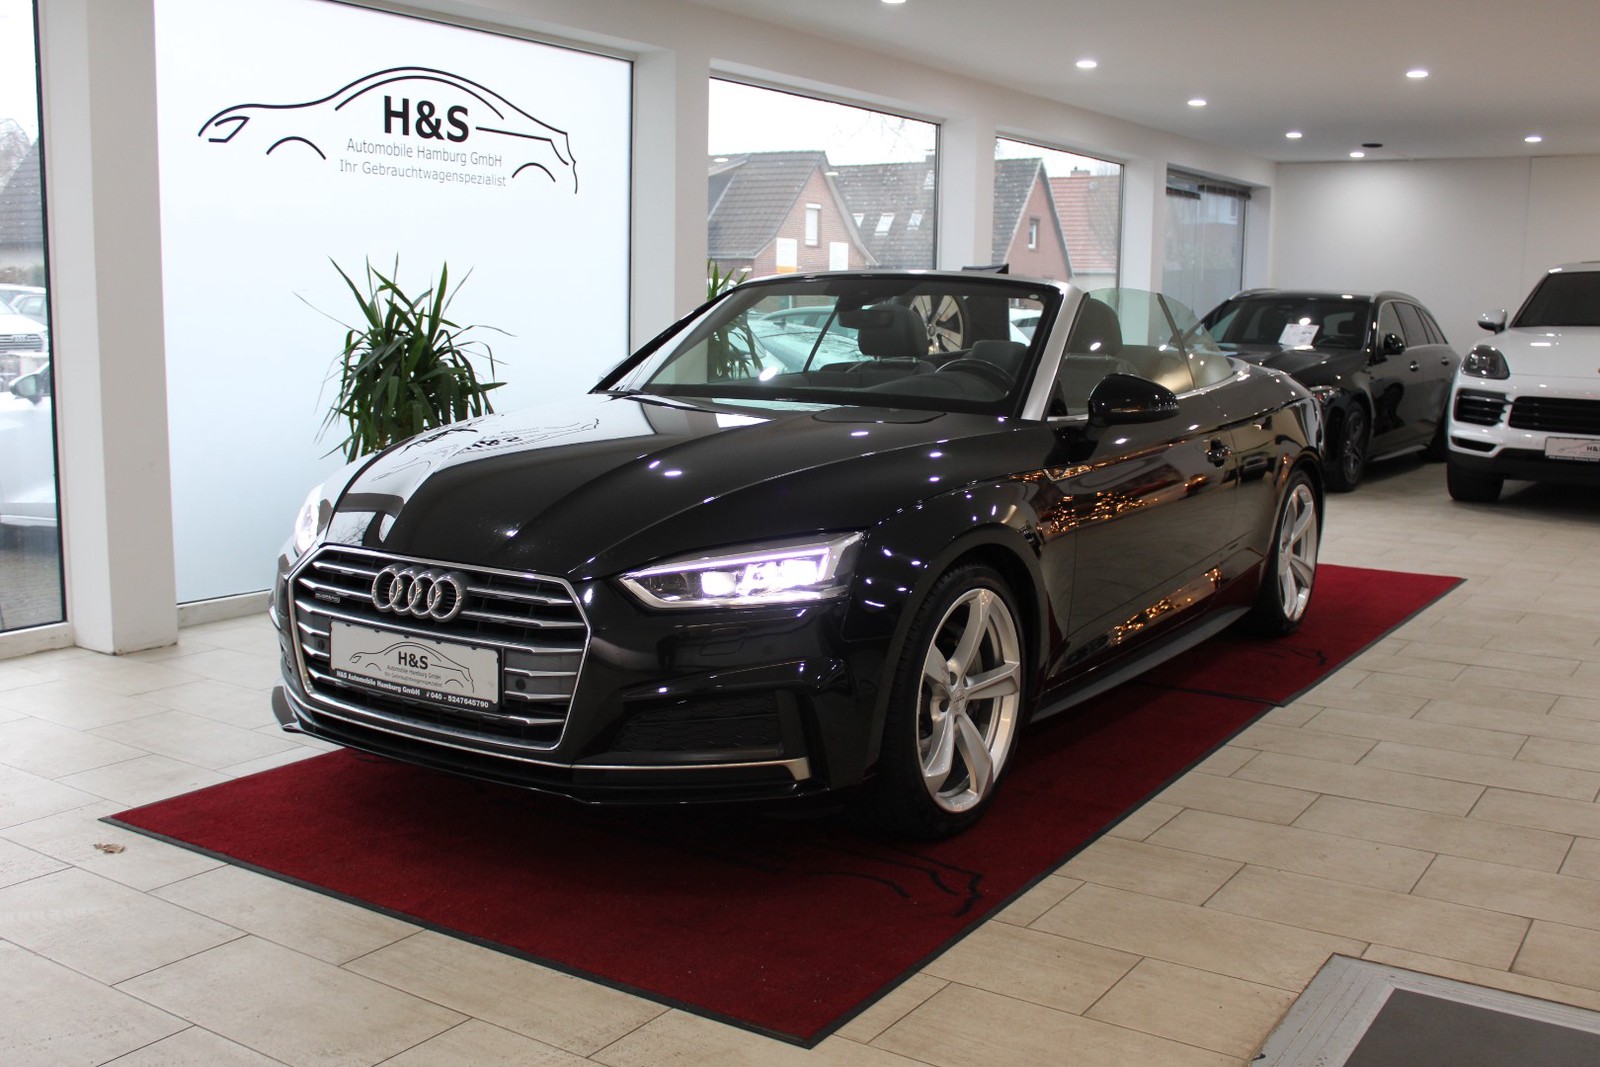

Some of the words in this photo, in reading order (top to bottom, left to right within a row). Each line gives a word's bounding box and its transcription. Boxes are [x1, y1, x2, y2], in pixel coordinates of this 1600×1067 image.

[384, 95, 469, 142] H&S
[346, 137, 413, 160] Automobile
[416, 145, 468, 166] Hamburg
[470, 151, 503, 168] GmbH
[339, 159, 357, 173] Ihr
[362, 161, 507, 187] Gebrauchtwagenspezialist
[398, 651, 428, 670] H&S
[348, 673, 376, 686] Automobile
[376, 680, 402, 693] Hamburg
[402, 685, 421, 696] GmbH
[430, 691, 443, 700] 040
[447, 694, 489, 708] 5247645790
